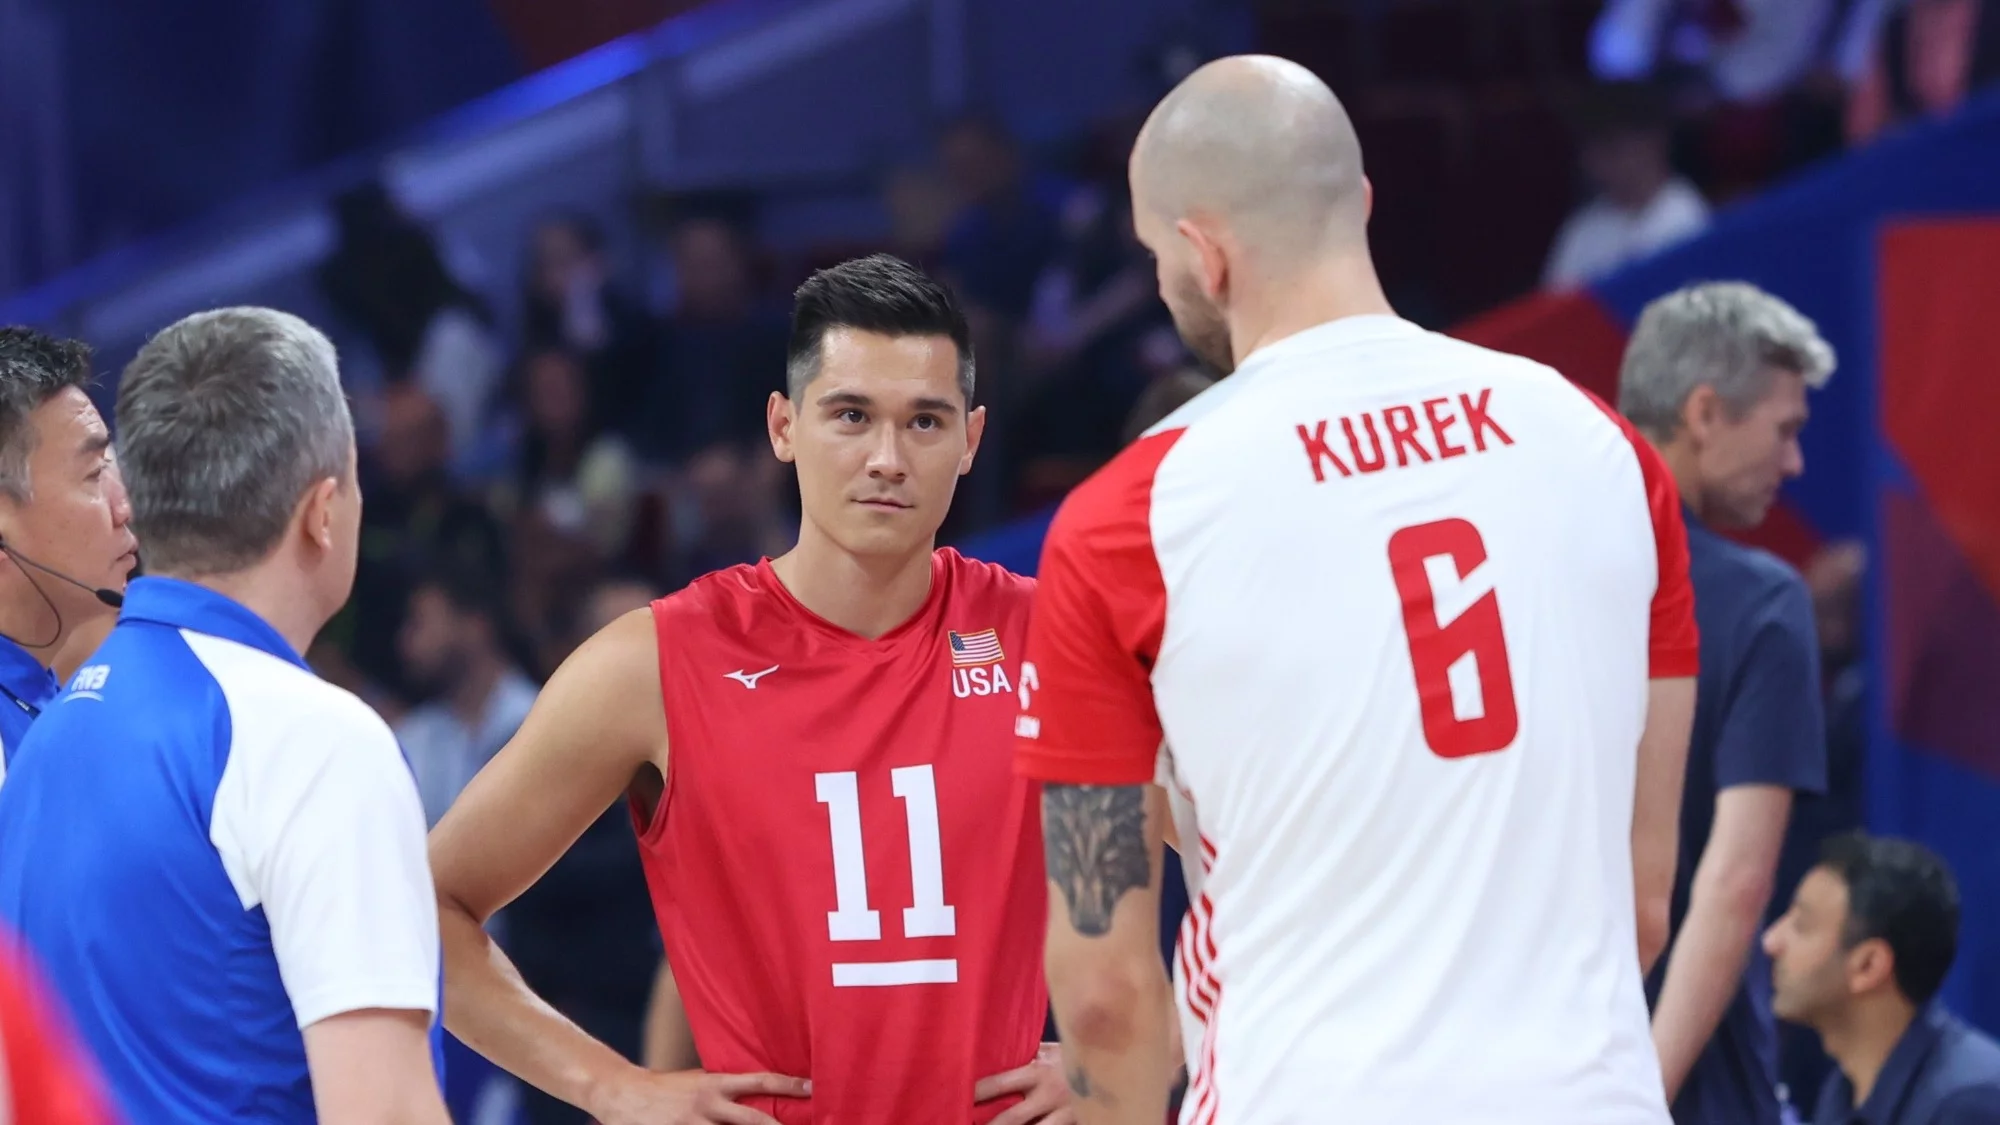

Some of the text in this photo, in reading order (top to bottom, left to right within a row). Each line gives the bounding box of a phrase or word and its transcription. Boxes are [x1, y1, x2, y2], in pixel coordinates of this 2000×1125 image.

[1296, 388, 1514, 483] KUREK
[952, 664, 1012, 698] USA
[1388, 517, 1519, 760] 6
[814, 763, 956, 941] 11
